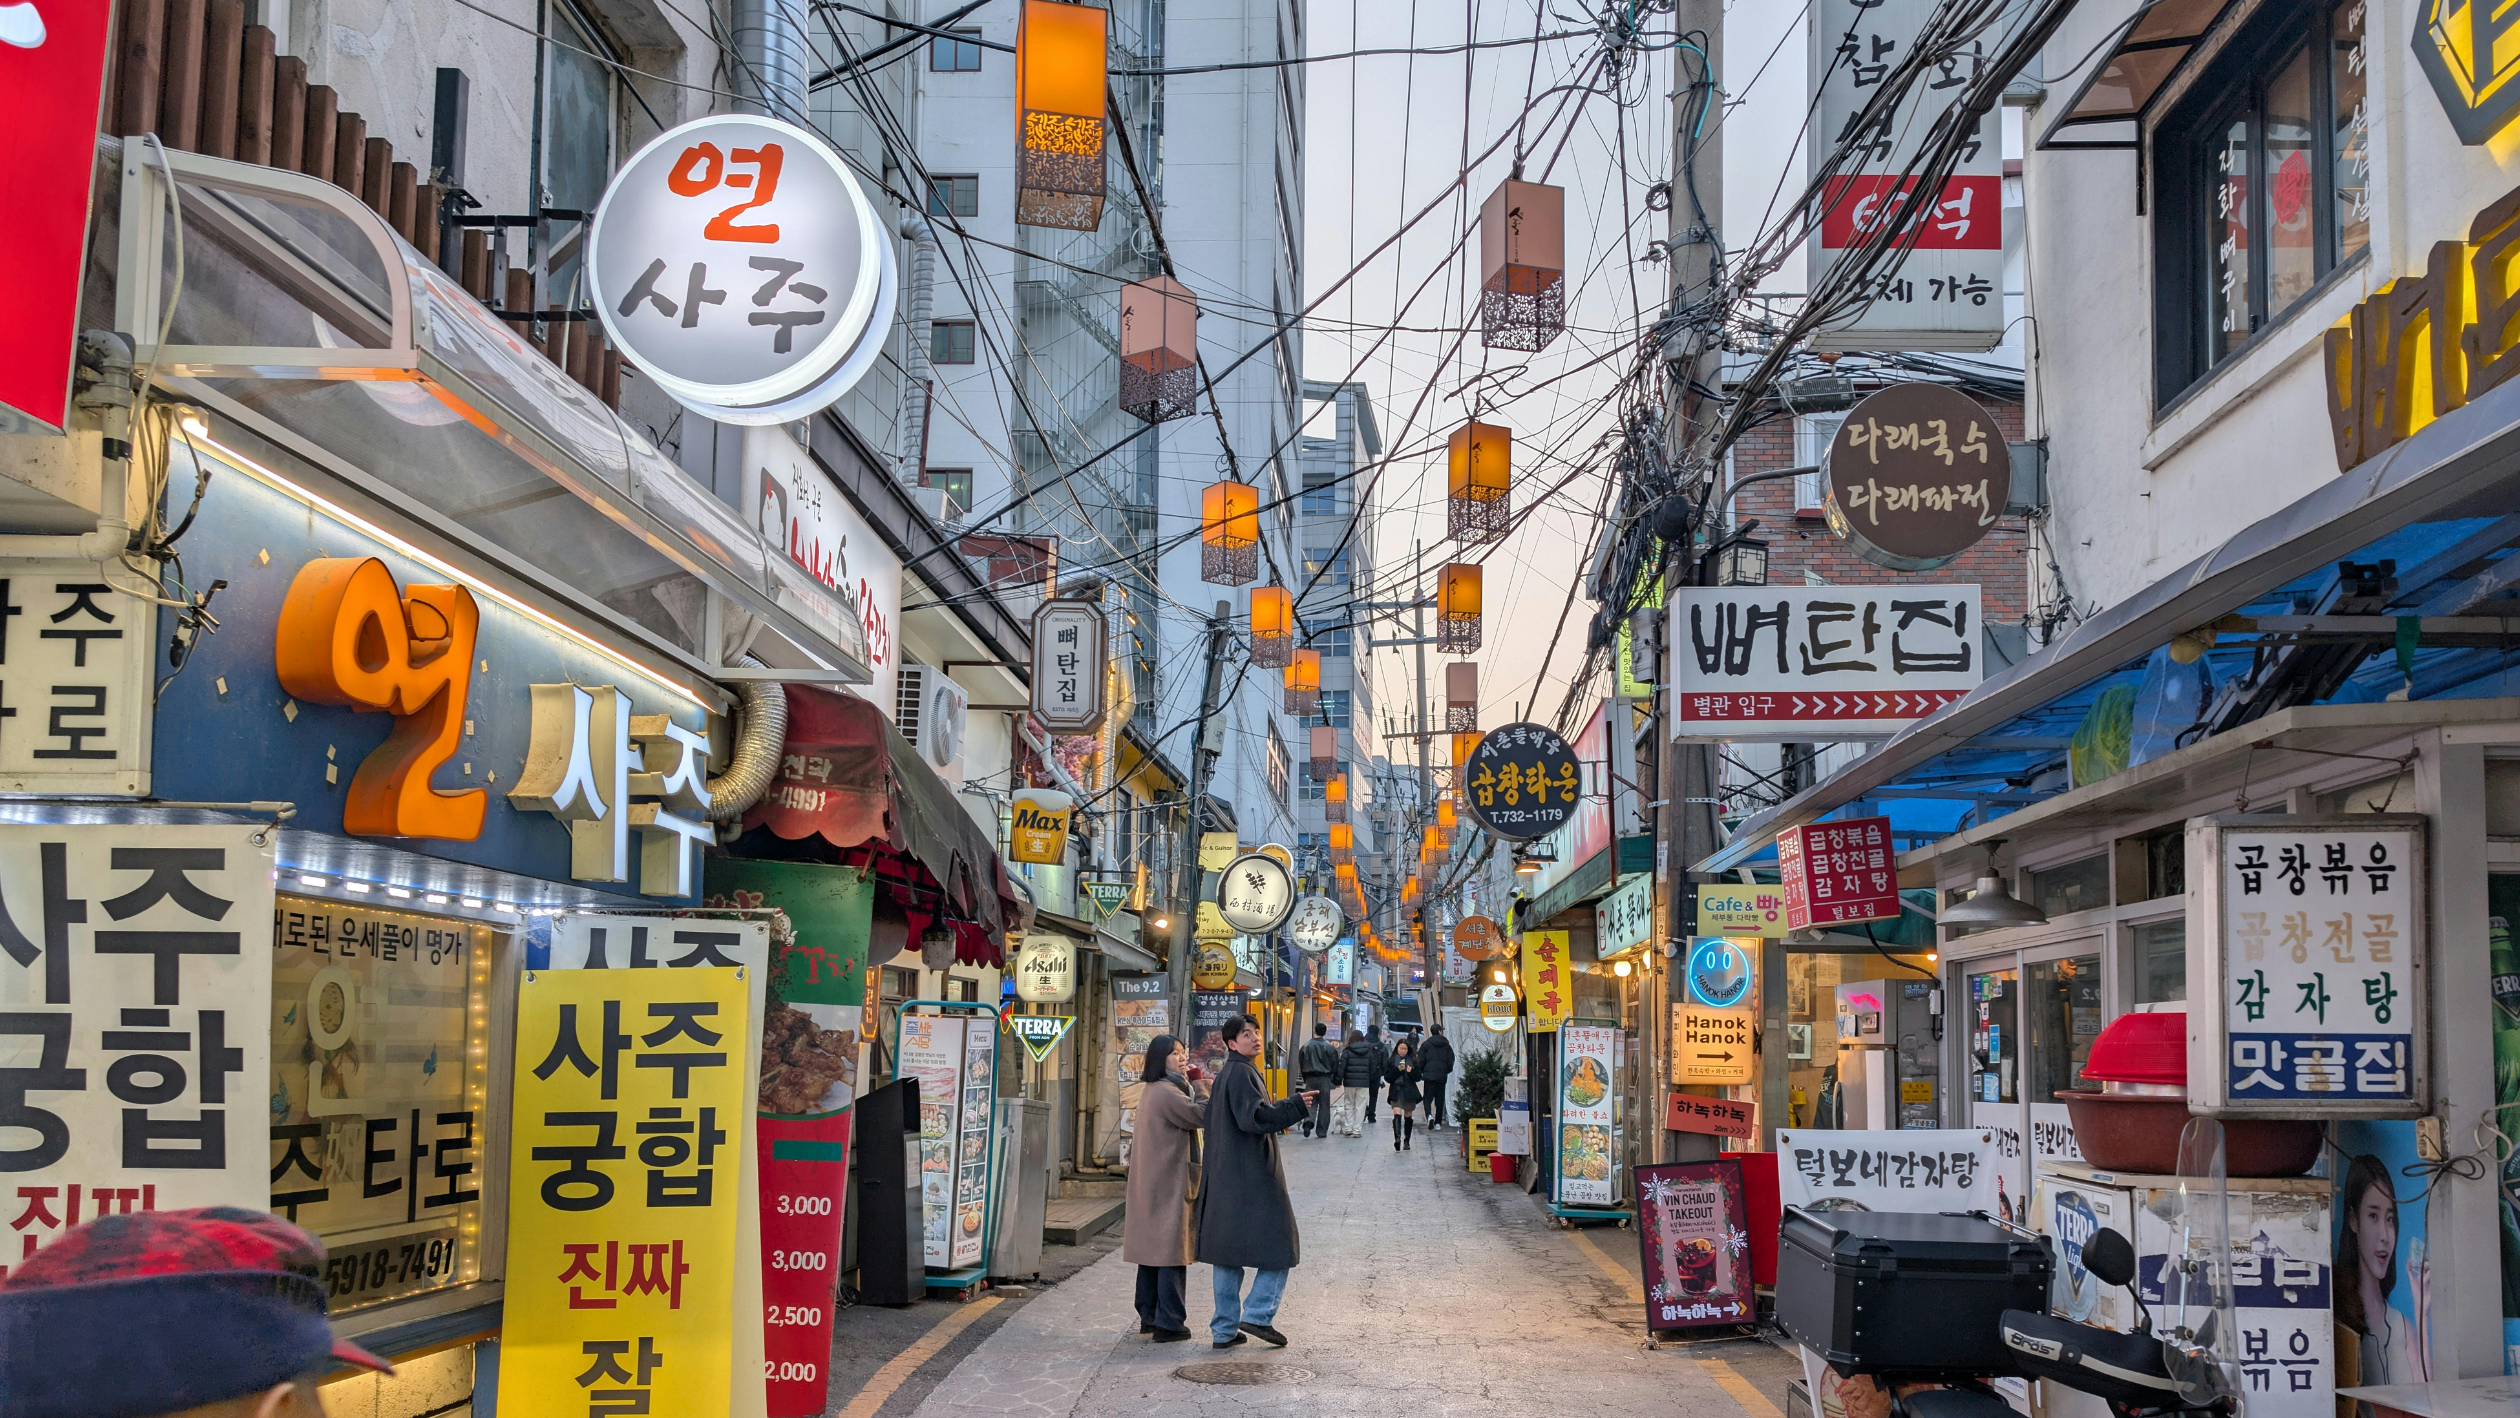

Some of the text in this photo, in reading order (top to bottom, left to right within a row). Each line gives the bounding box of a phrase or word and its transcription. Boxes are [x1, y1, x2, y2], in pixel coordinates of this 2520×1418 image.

[668, 141, 784, 244] 열
[1929, 272, 1993, 306] 가능
[617, 256, 828, 354] 사주
[1847, 416, 1988, 465] 다래국수
[1847, 478, 1997, 527] 다래파전
[1690, 600, 1971, 676] 뼈탄집
[1056, 625, 1080, 703] 뼈탄집
[275, 556, 488, 842] 열
[1694, 697, 1776, 717] 별관 입구
[507, 684, 716, 899] 사주
[1015, 809, 1064, 831] Max
[1490, 808, 1563, 824] T.732-1179
[1026, 830, 1051, 838] Cream
[1031, 839, 1044, 852] 生
[1809, 824, 1883, 851] 곱창볶음
[1812, 848, 1886, 875] 곱창전골
[2234, 841, 2397, 896] 곱창볶음
[1089, 885, 1128, 899] TERRA
[1815, 872, 1888, 898] 감자탕
[1304, 900, 1331, 919] 동해
[1704, 896, 1742, 911] Cafe
[1745, 901, 1753, 911] &
[1756, 895, 1783, 922] 빵
[1832, 902, 1875, 920] 털보집
[0, 842, 241, 1005] 사주
[1294, 917, 1335, 938] 남부선
[1464, 922, 1485, 935] 서촌
[338, 917, 418, 962] 운세풀이
[426, 929, 462, 965] 명가
[2236, 911, 2398, 963] 곱창전골
[1024, 956, 1067, 973] Asahi
[1039, 976, 1052, 984] 生
[1119, 981, 1160, 993] The 9.2
[1533, 937, 1562, 1016] 순대국
[1697, 974, 1745, 998] HANOK HANOK
[1487, 1004, 1512, 1013] Kloud
[2234, 969, 2398, 1025] 감자탕
[1014, 1018, 1062, 1036] TERRA
[1686, 1015, 1746, 1029] Hanok
[1686, 1030, 1746, 1044] Hanok
[533, 1000, 728, 1100] 사주
[0, 1008, 243, 1172] 궁합
[1676, 1100, 1746, 1123] 하녹하녹
[1714, 1125, 1729, 1133] 20m
[363, 1108, 480, 1224] 타로
[531, 1107, 726, 1213] 궁합
[1795, 1148, 1980, 1189] 털보네감자탕
[777, 1195, 831, 1216] 3,000
[1664, 1192, 1716, 1206] VIN CHAUD
[1669, 1206, 1714, 1220] TAKEOUT
[772, 1250, 826, 1272] 3,000
[557, 1240, 690, 1310] 진짜
[767, 1306, 821, 1327] 2,500
[1661, 1303, 1722, 1321] 하녹하녹
[764, 1361, 816, 1383] 2,000
